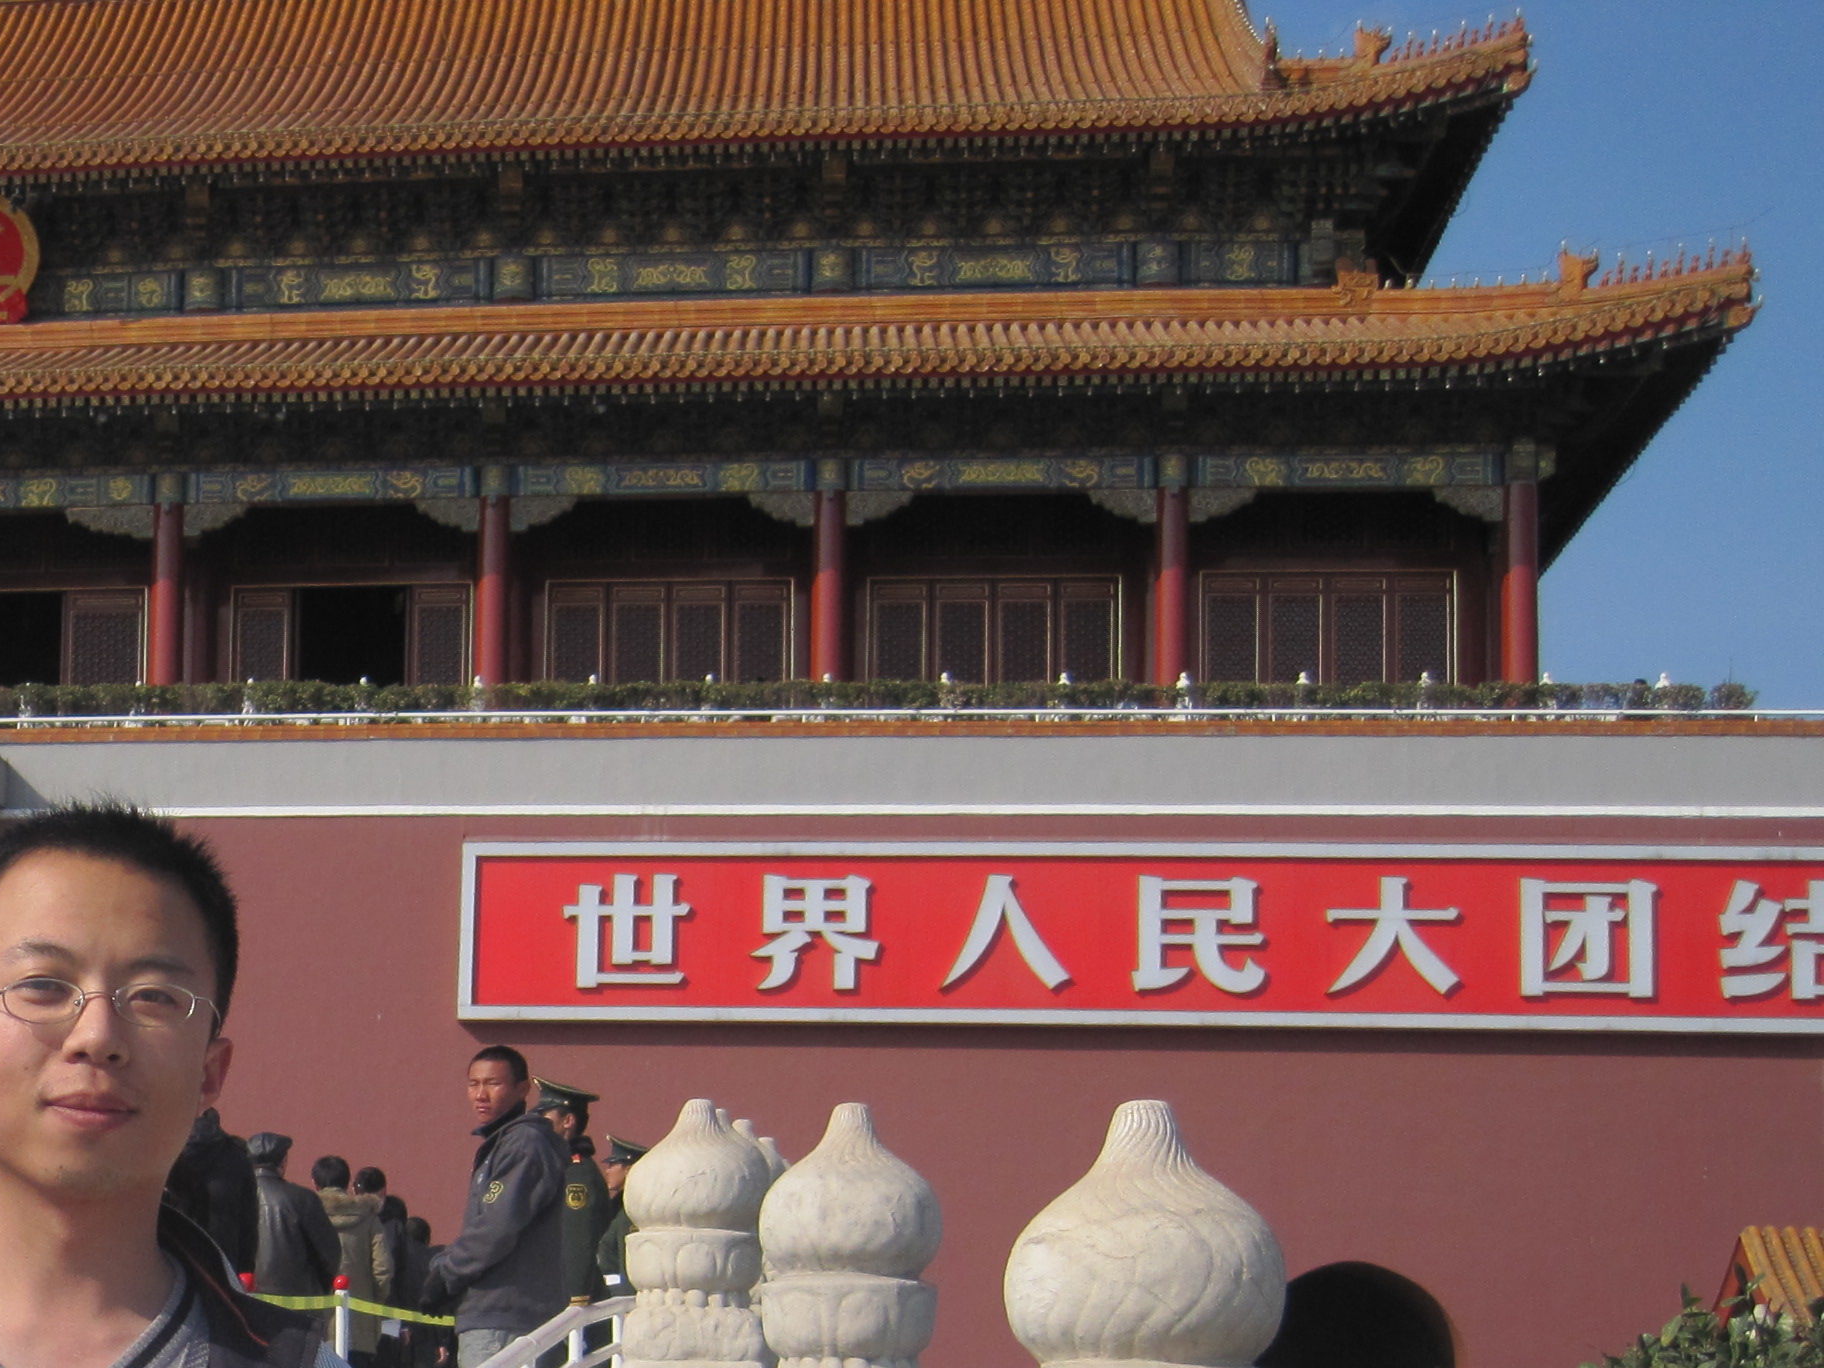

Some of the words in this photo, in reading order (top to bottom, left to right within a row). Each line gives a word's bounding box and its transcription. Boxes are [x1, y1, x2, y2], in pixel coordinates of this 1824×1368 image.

[562, 874, 1824, 1000] 世界人民大团结
